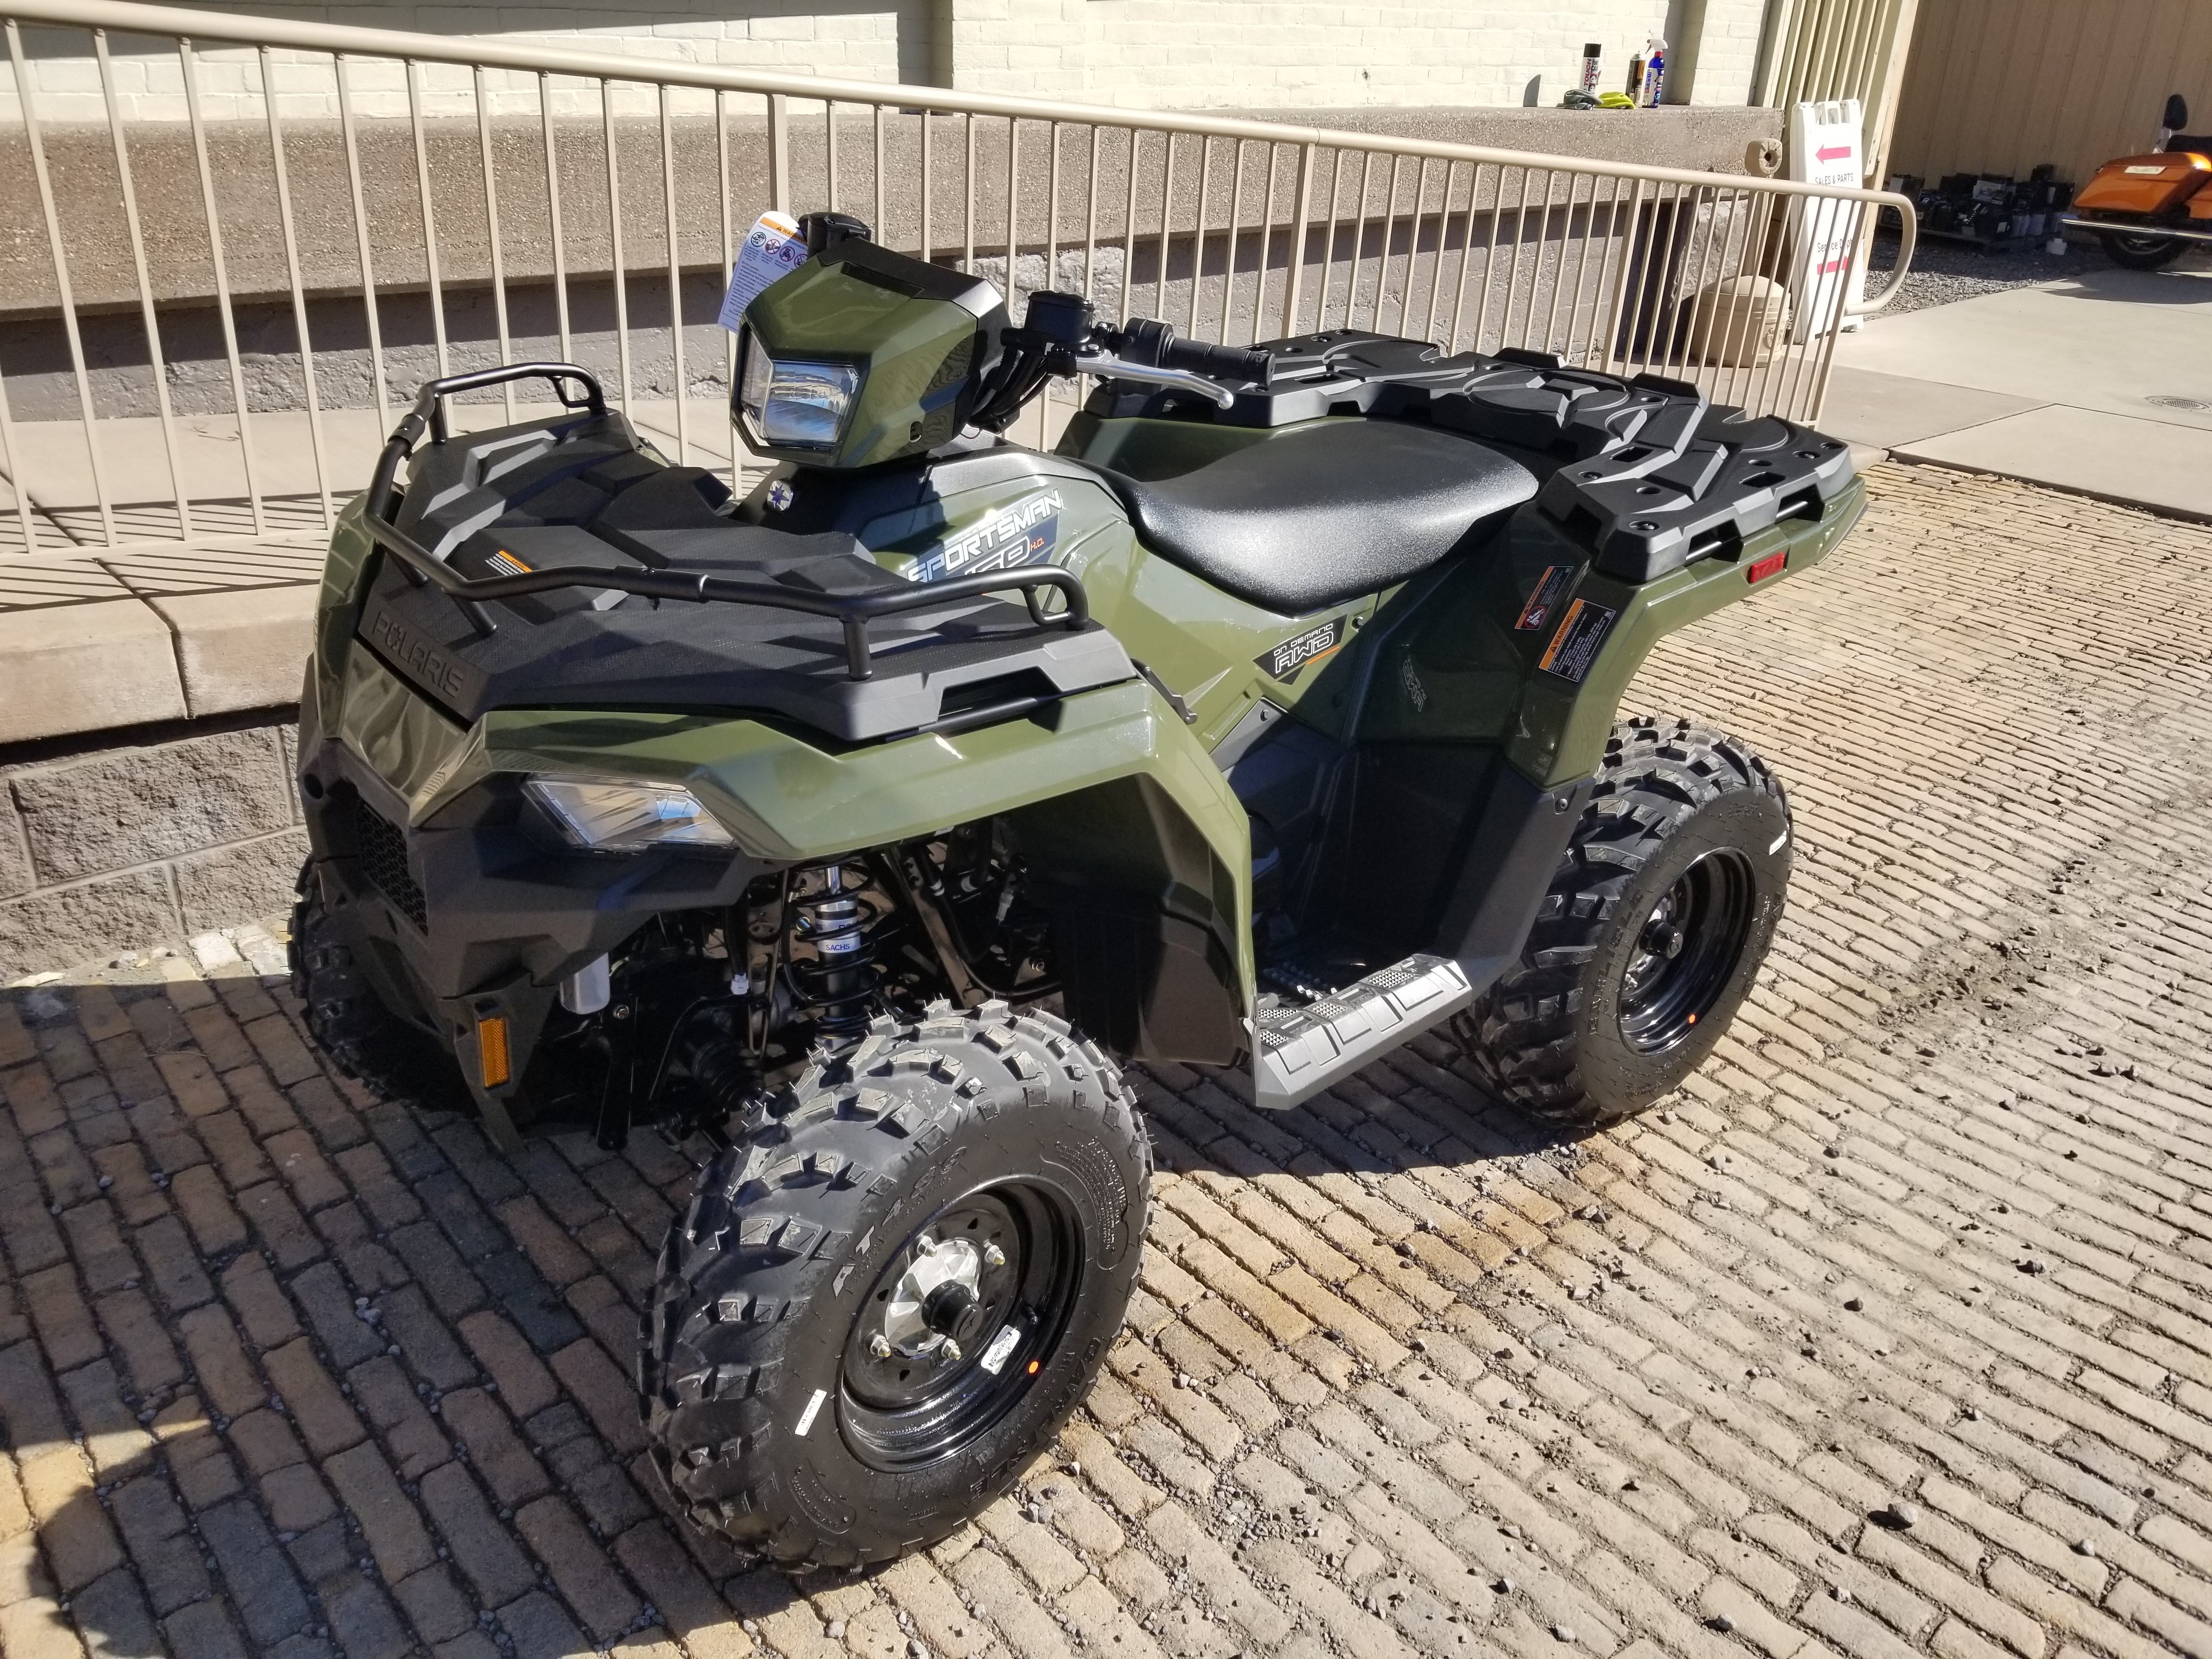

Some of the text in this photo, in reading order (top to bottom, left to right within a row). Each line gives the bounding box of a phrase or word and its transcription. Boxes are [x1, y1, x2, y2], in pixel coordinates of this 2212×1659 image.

[1815, 173, 1854, 185] SALES & PARTS
[1817, 242, 1838, 253] Serce
[907, 488, 1064, 583] SPORTSMAN
[1526, 580, 1545, 611] WARNING
[1273, 623, 1334, 657] ON DEMAND
[1553, 615, 1574, 648] WARNING
[371, 611, 464, 698] POLARIS
[1274, 630, 1334, 675] AWD
